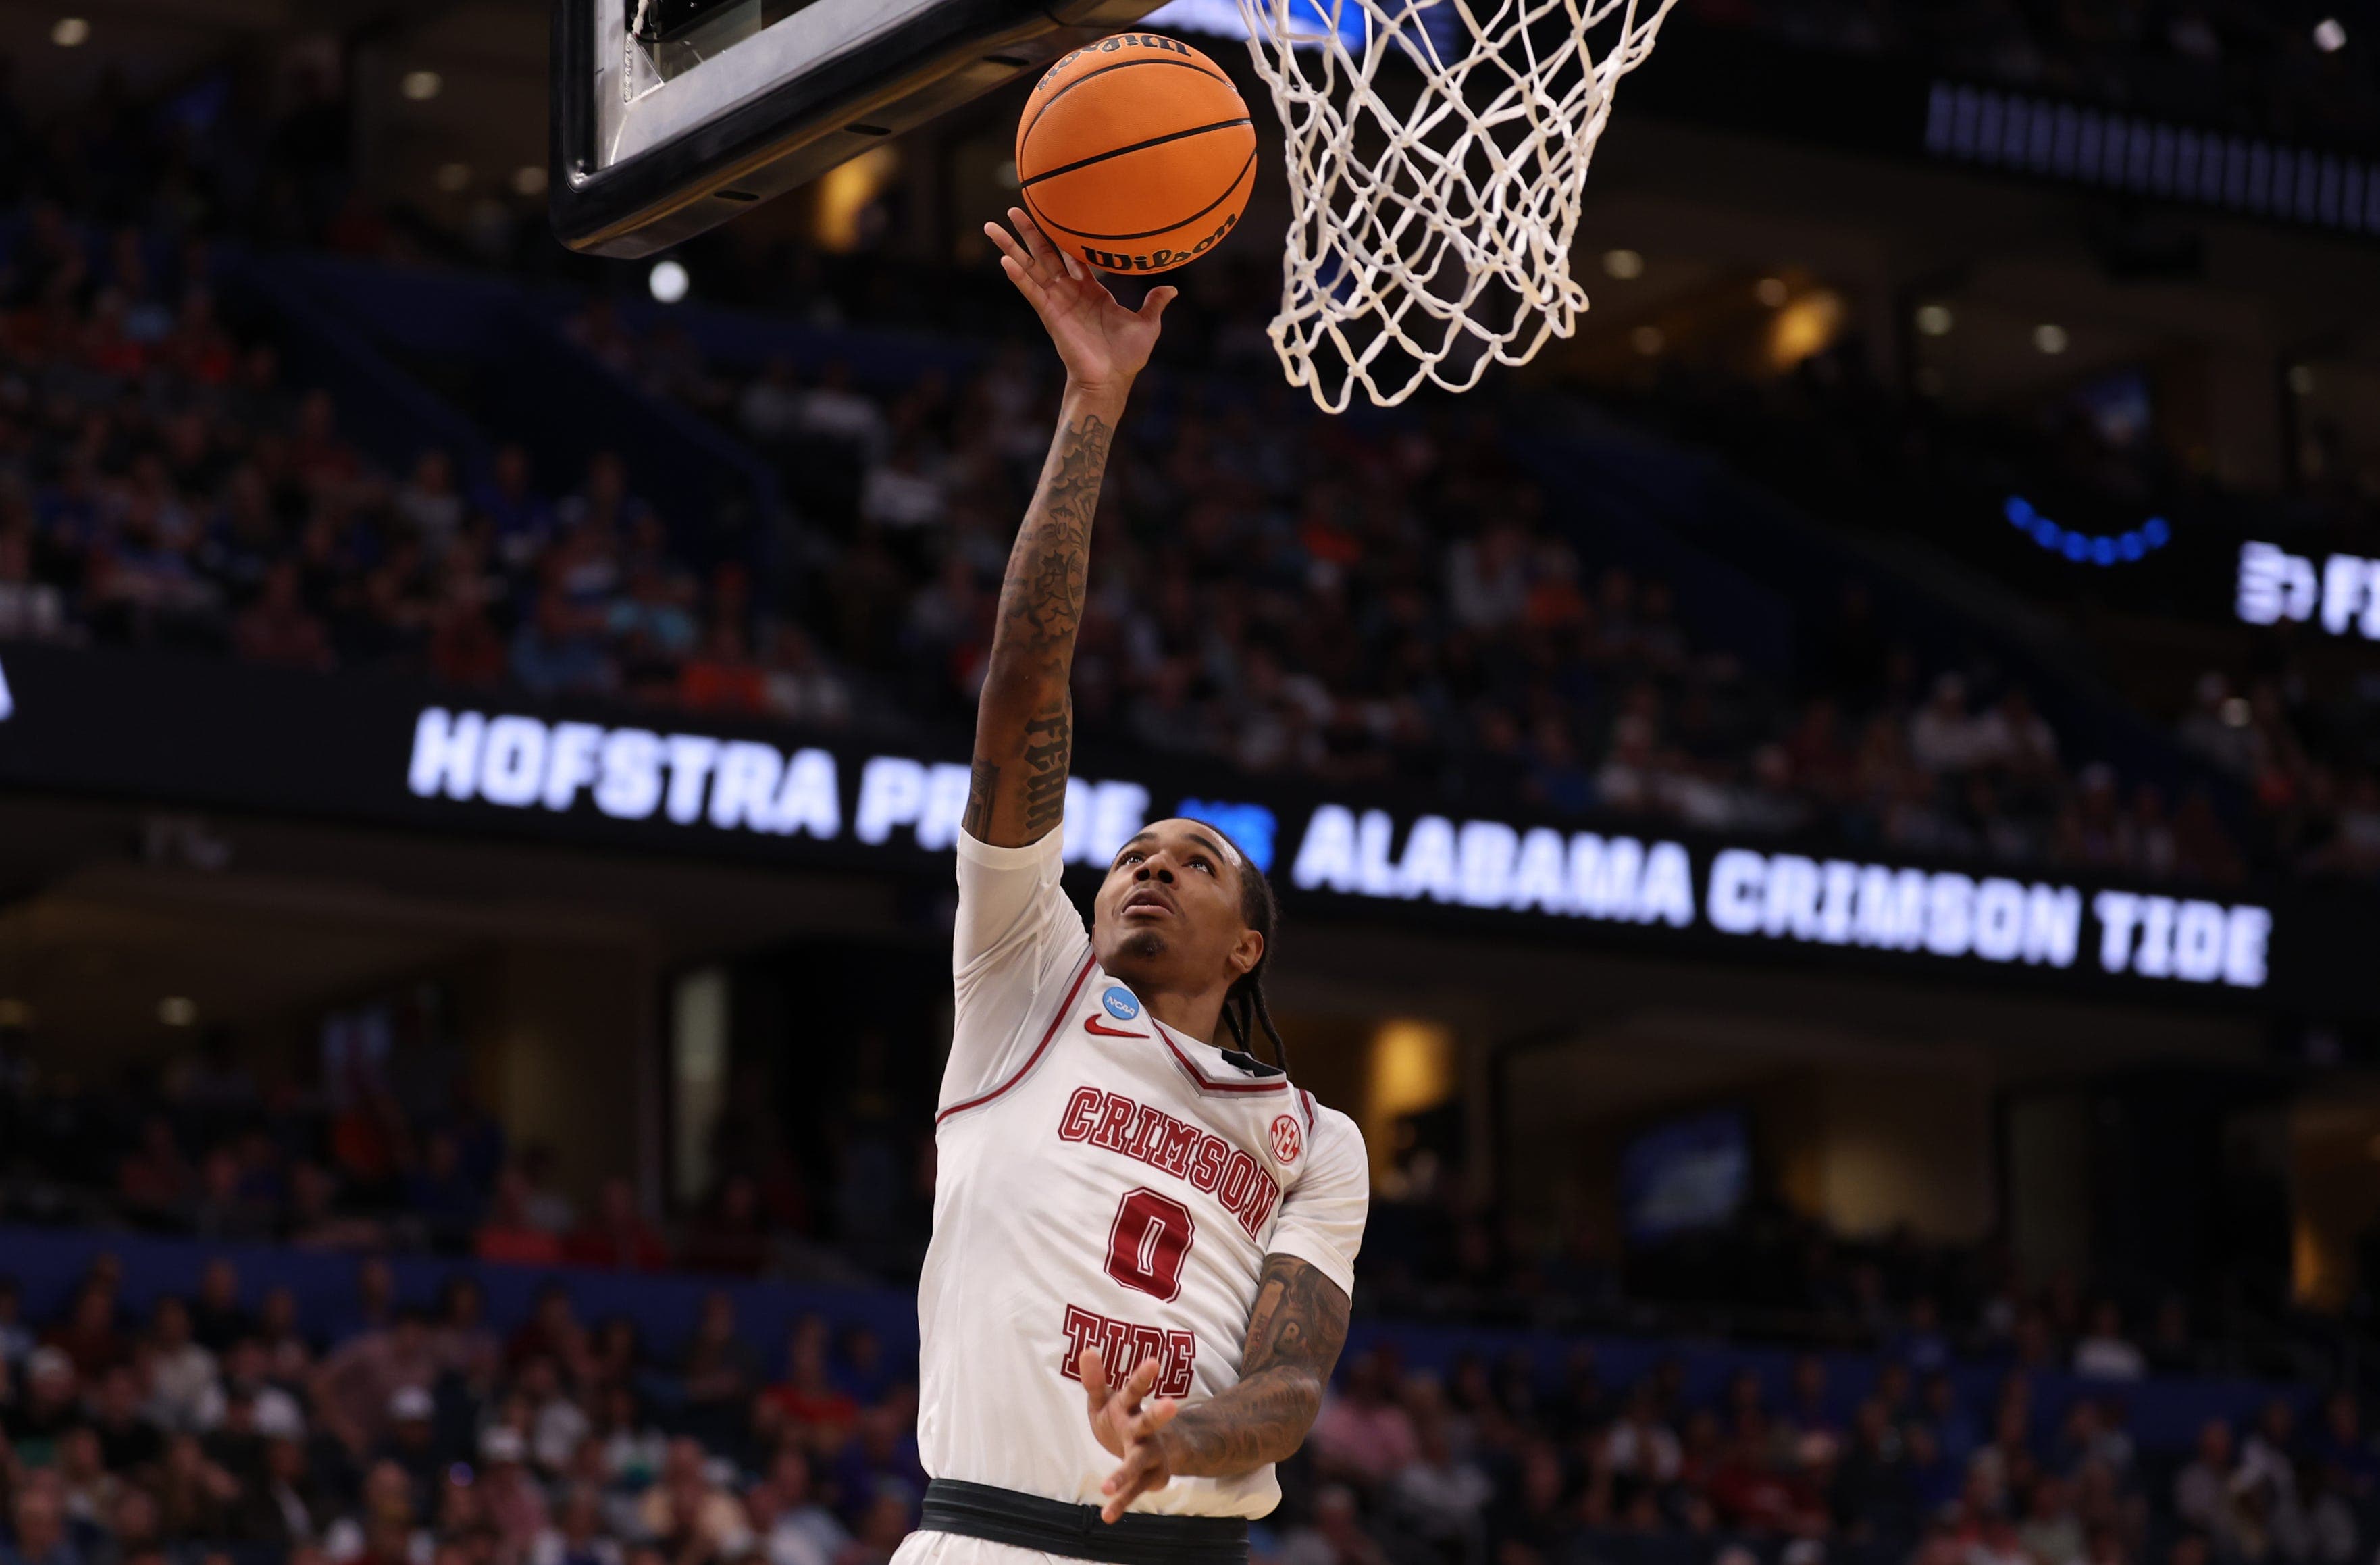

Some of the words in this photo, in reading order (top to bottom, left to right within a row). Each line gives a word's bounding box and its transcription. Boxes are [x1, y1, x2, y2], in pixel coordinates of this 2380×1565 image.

[1081, 213, 1237, 271] Wilson
[409, 708, 840, 838] HOFSTRA
[856, 757, 1148, 868] PRDE
[1293, 805, 1694, 927] ALABAMA
[1707, 850, 2081, 967] CRIMSON
[2094, 891, 2271, 986] TIDE
[1106, 996, 1135, 1017] NCAA
[1058, 1085, 1280, 1242] CRIMSON
[1272, 1117, 1300, 1160] SEC
[1104, 1186, 1195, 1304] 0
[1060, 1304, 1196, 1399] TIDE
